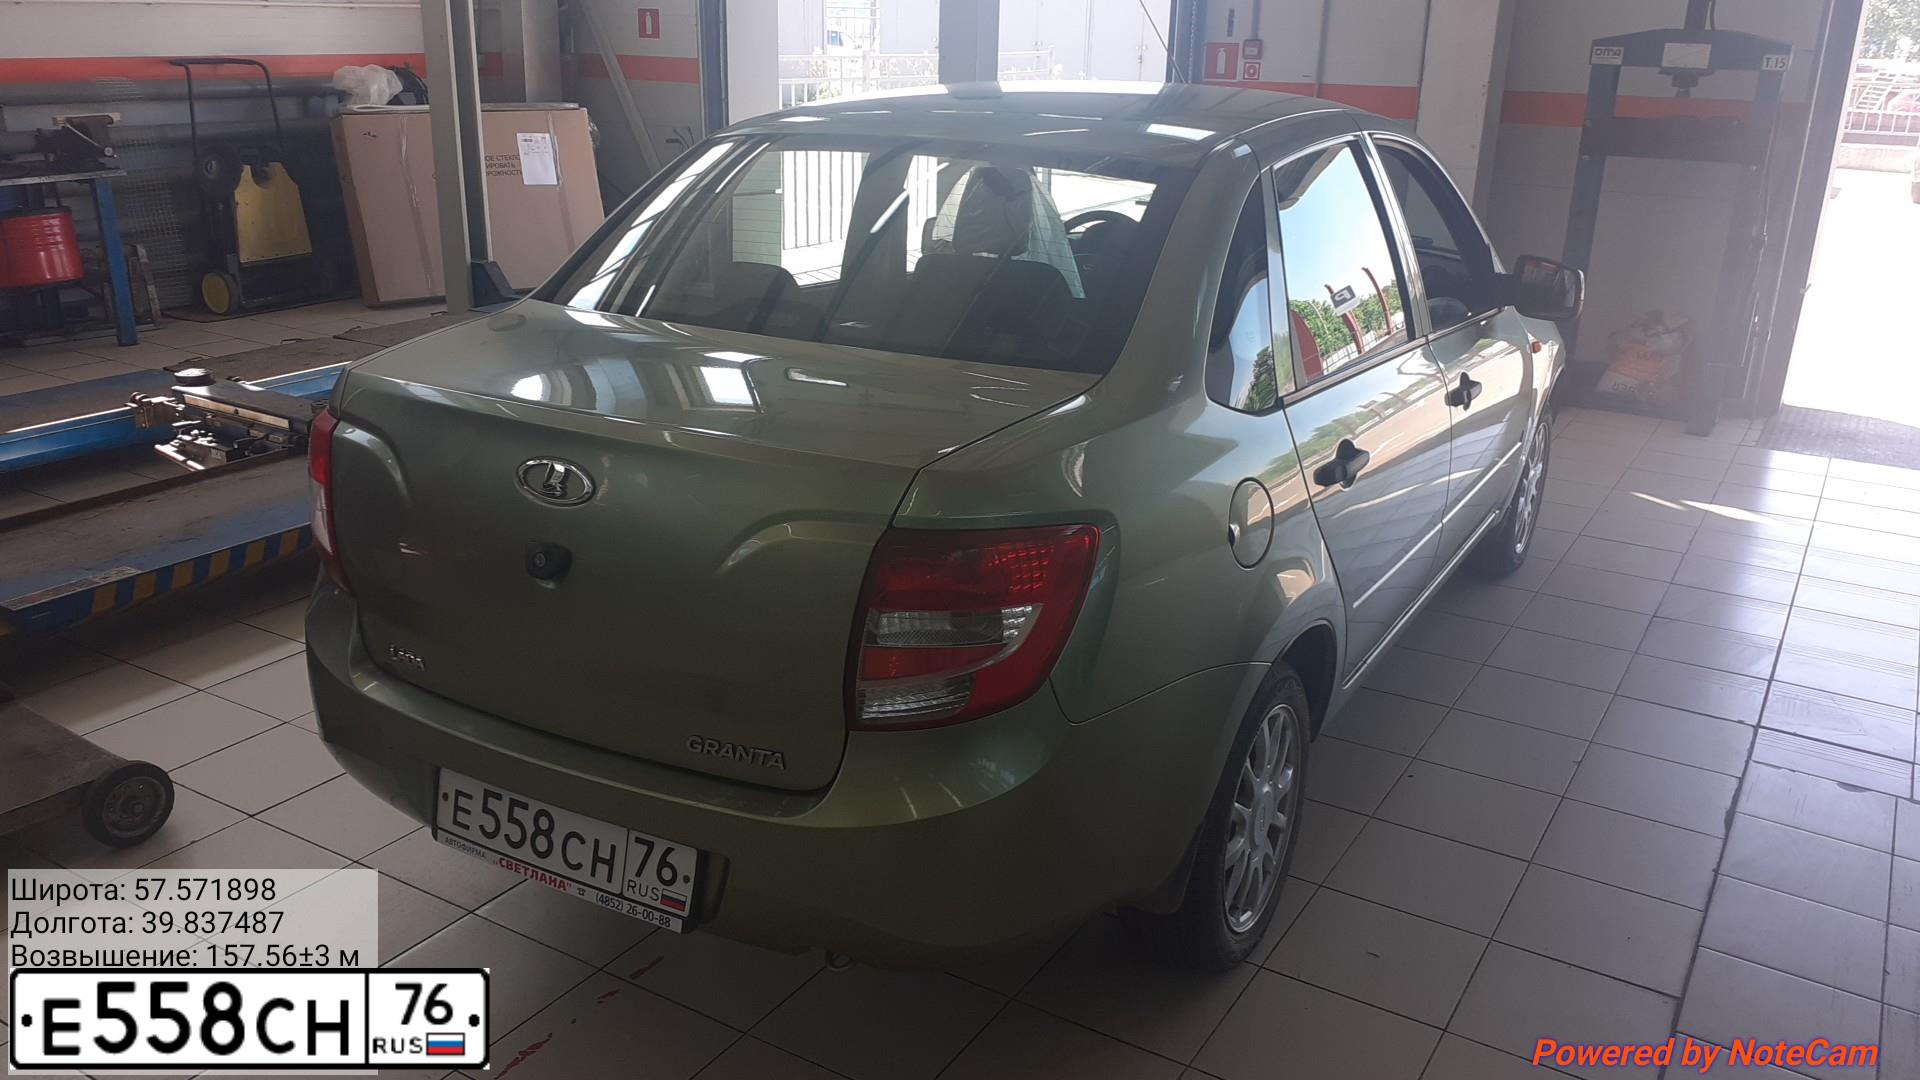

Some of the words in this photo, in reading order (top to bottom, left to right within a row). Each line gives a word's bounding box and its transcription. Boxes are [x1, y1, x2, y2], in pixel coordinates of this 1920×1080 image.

[686, 734, 785, 770] GRANTA
[634, 836, 678, 886] 76
[626, 879, 660, 902] RUS
[595, 891, 624, 912] (4852)
[626, 903, 672, 928] 26-00-88
